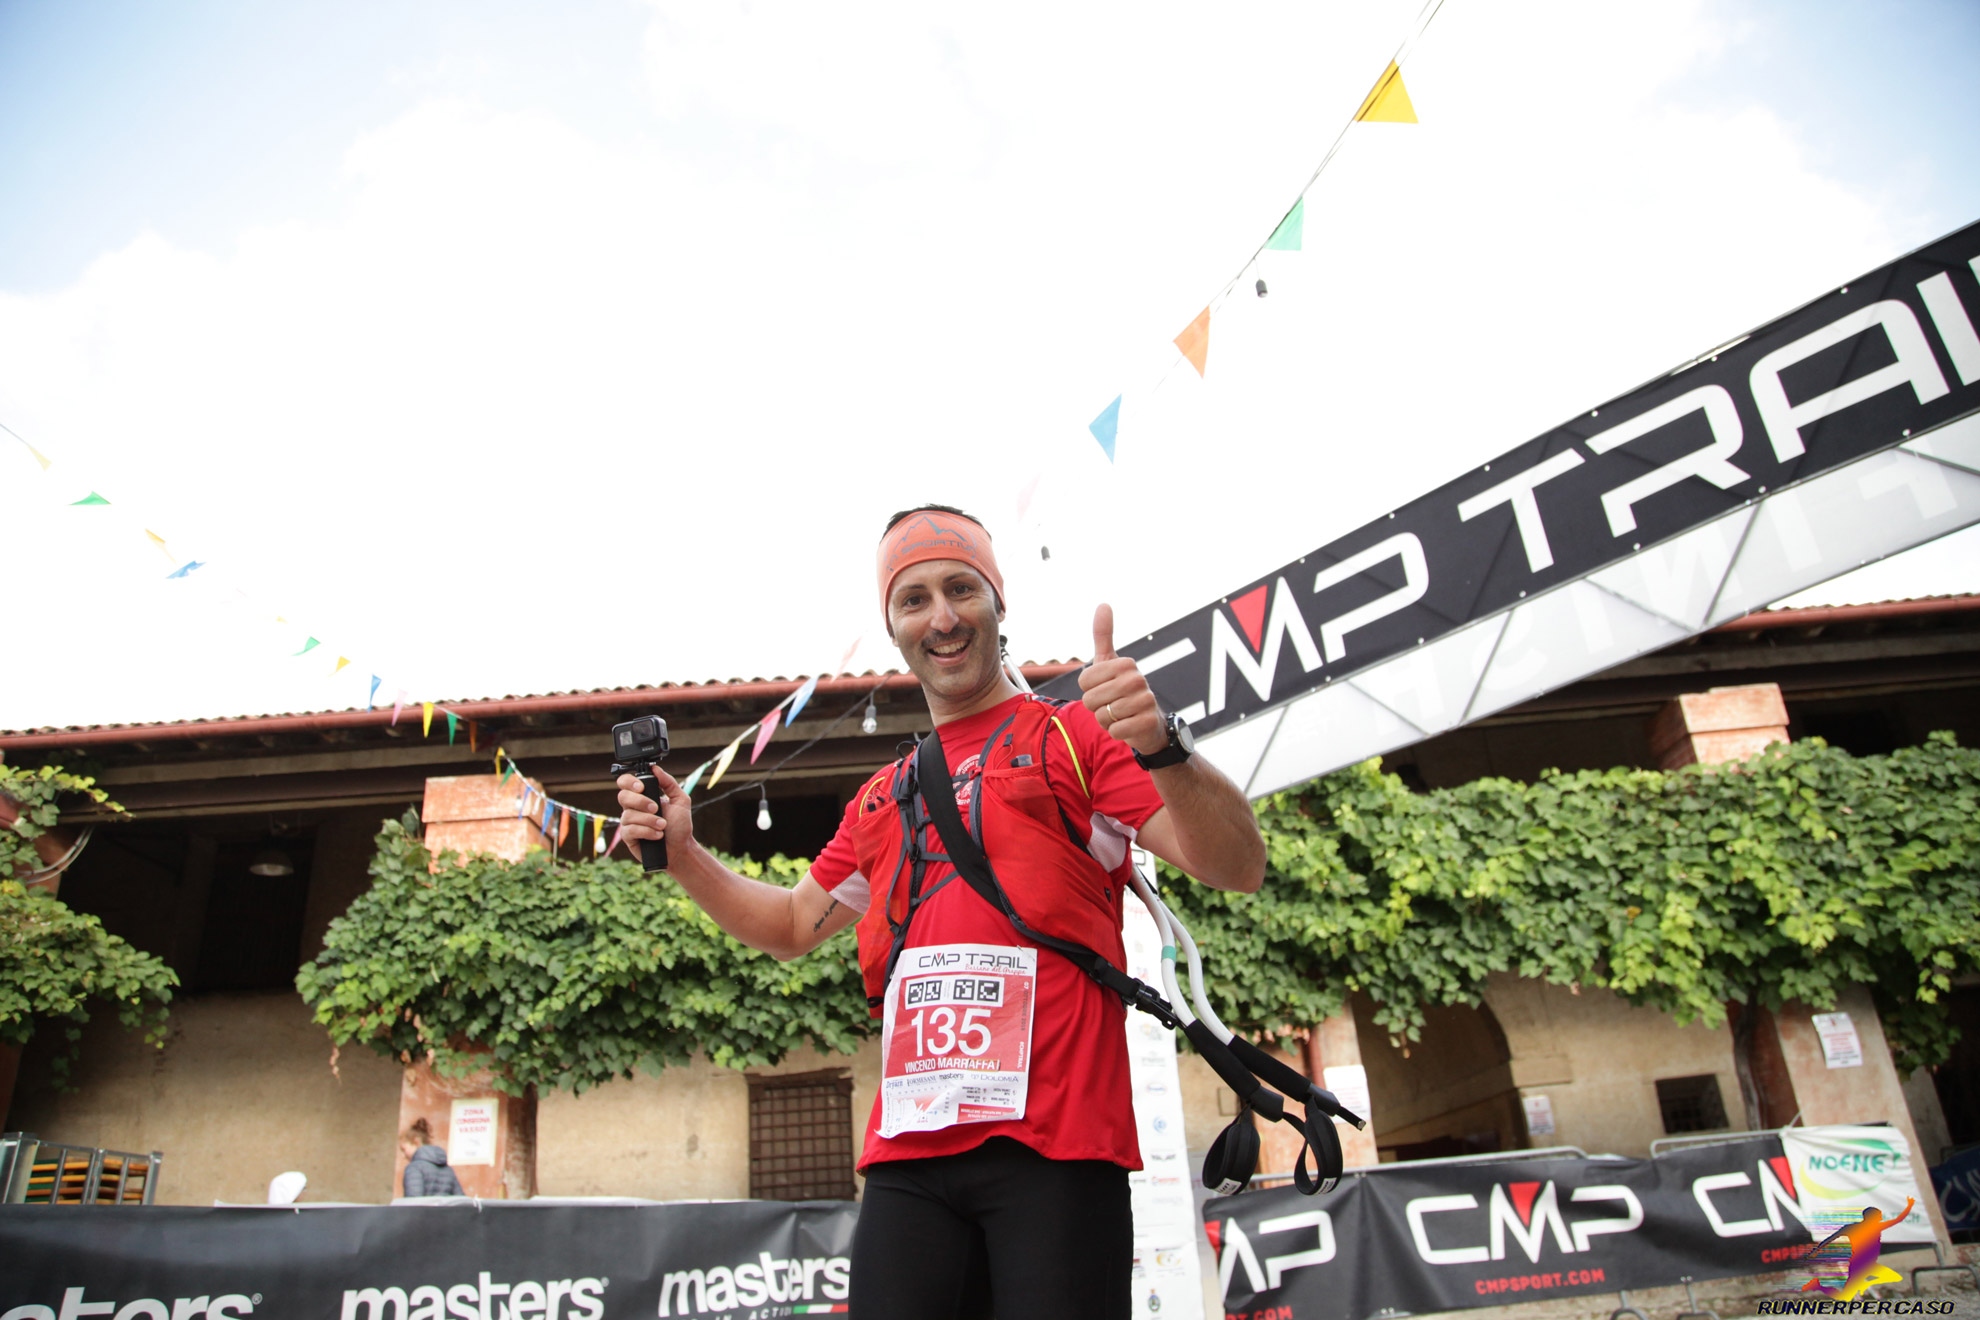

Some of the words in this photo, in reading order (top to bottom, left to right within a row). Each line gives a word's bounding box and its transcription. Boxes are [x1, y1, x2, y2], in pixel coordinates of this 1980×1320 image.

[1457, 254, 1980, 573] TRAI
[919, 953, 960, 968] CMP
[965, 953, 1028, 969] TRAIL
[911, 1006, 992, 1057] 135
[905, 1058, 936, 1073] VINCENZO
[939, 1072, 965, 1080] masters
[1405, 1179, 1645, 1265] CMP
[658, 1252, 851, 1318] masters
[1475, 1268, 1606, 1295] CMPSPORT.COM
